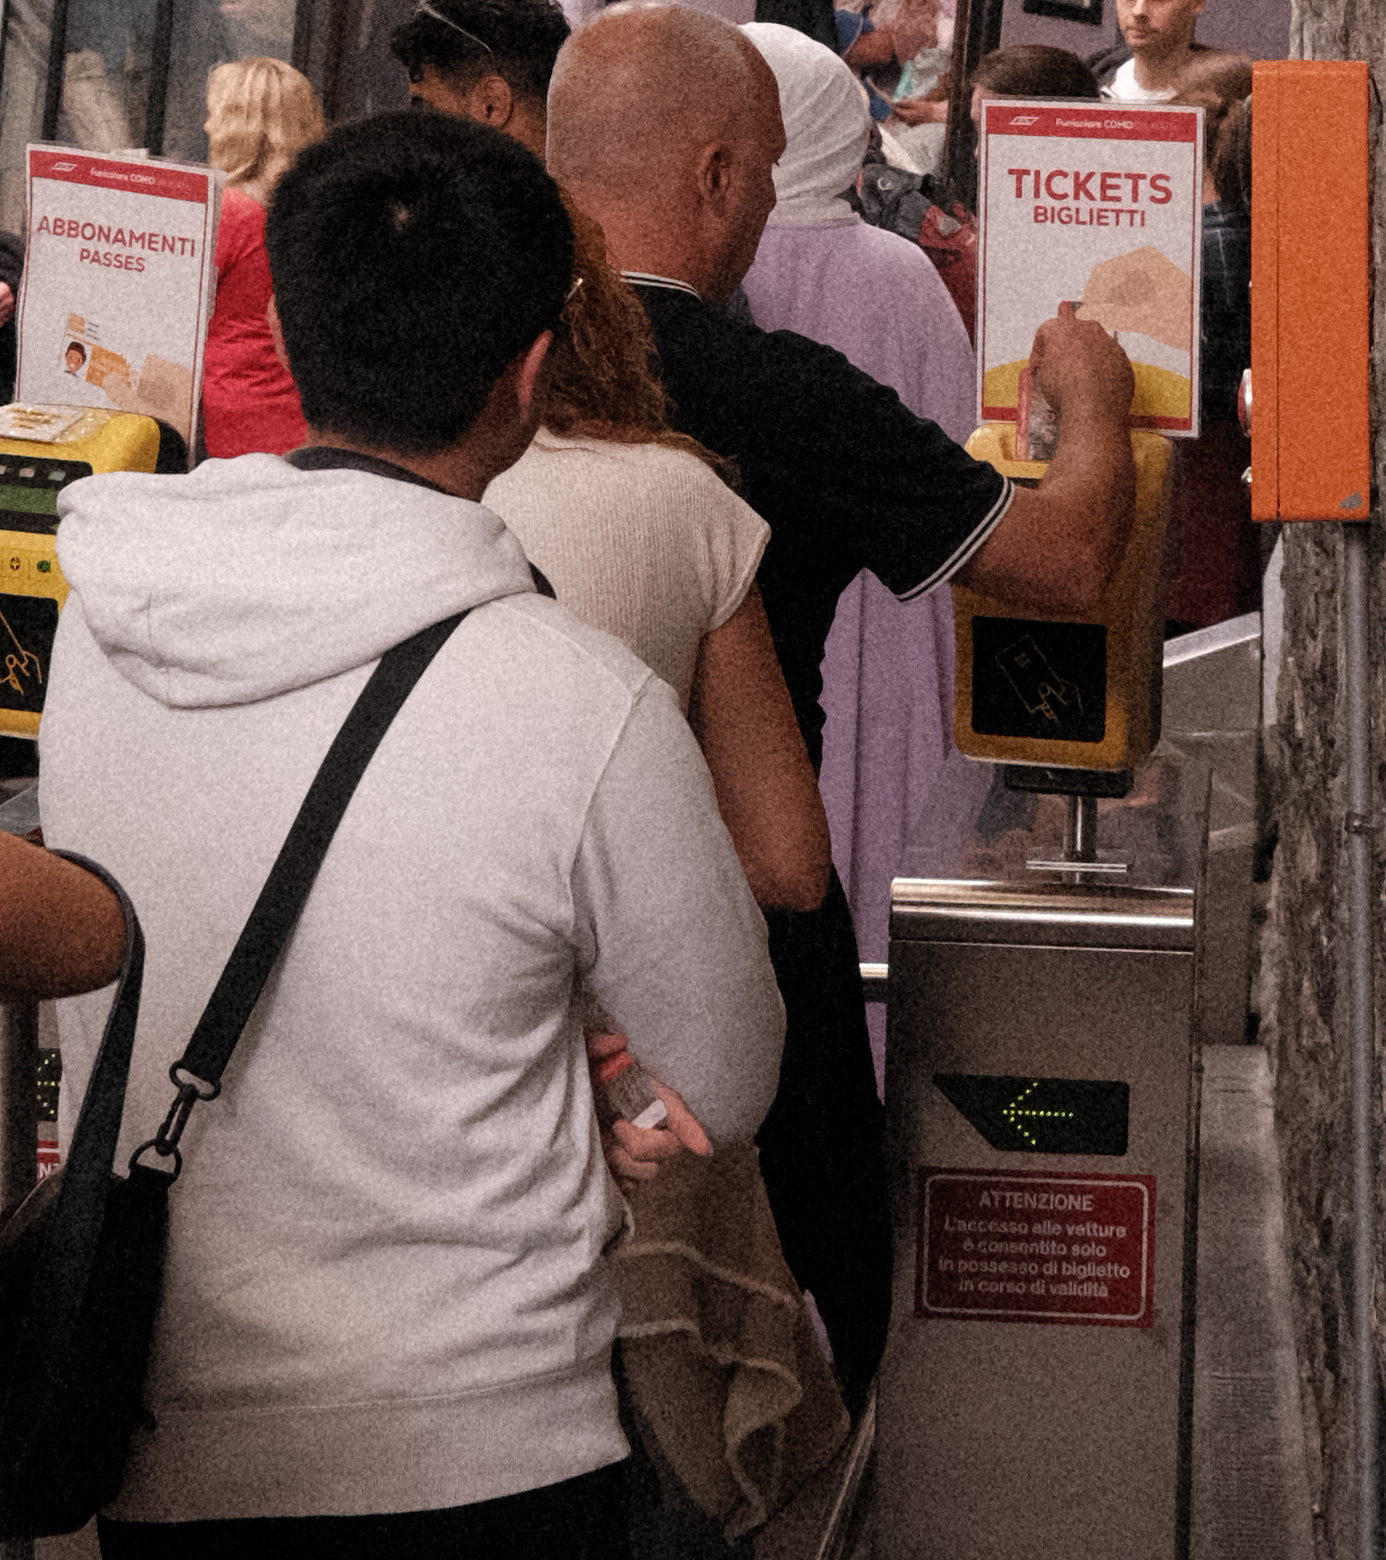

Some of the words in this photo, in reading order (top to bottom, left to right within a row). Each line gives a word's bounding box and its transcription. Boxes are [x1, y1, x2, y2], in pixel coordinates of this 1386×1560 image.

[1008, 168, 1172, 205] TICKETS
[1034, 206, 1146, 227] BIGLIETTI
[38, 215, 196, 258] ABBONAMENTI
[79, 247, 146, 274] PASSES
[978, 1191, 1094, 1211] ATTENZIONE
[944, 1215, 1028, 1234] L'accesso
[1032, 1219, 1062, 1235] alle
[1067, 1222, 1127, 1238] vetture
[963, 1237, 974, 1251] è
[978, 1238, 1067, 1255] consentito
[1071, 1242, 1107, 1257] solo
[939, 1257, 954, 1272] in
[958, 1260, 1038, 1275] possesso
[1043, 1261, 1058, 1276] di
[1062, 1261, 1131, 1280] biglietto
[959, 1279, 974, 1292] in
[978, 1282, 1026, 1295] corso
[1031, 1281, 1046, 1295] di
[1049, 1282, 1110, 1298] validità
